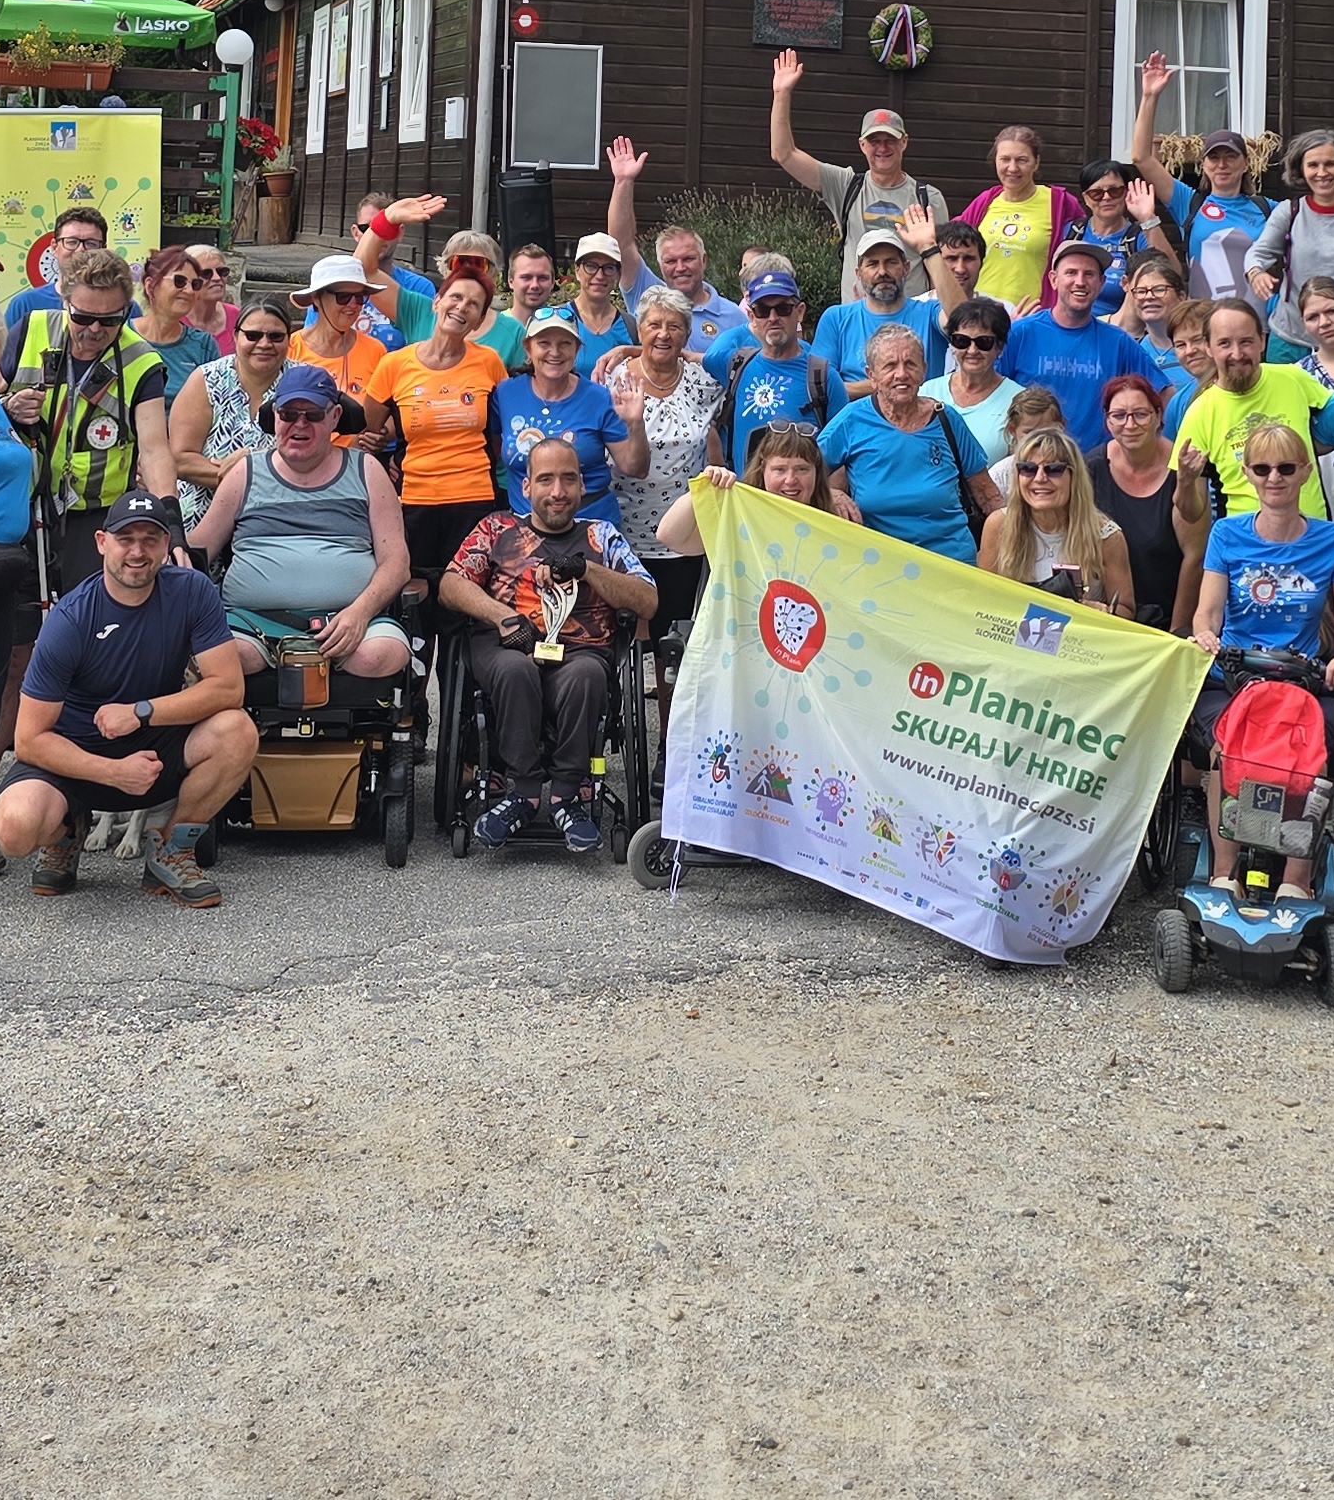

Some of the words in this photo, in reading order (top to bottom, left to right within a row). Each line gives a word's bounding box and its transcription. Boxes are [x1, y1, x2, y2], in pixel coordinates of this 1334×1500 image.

[975, 611, 1018, 629] PLANINSKA
[975, 628, 1015, 645] SLOVENIJE
[991, 623, 1016, 637] ZVEZA
[891, 710, 998, 760] SKUPAJ
[1003, 741, 1024, 768] V
[1025, 752, 1108, 801] HRIBE
[883, 748, 1096, 835] www.inplaninec.pzs.si
